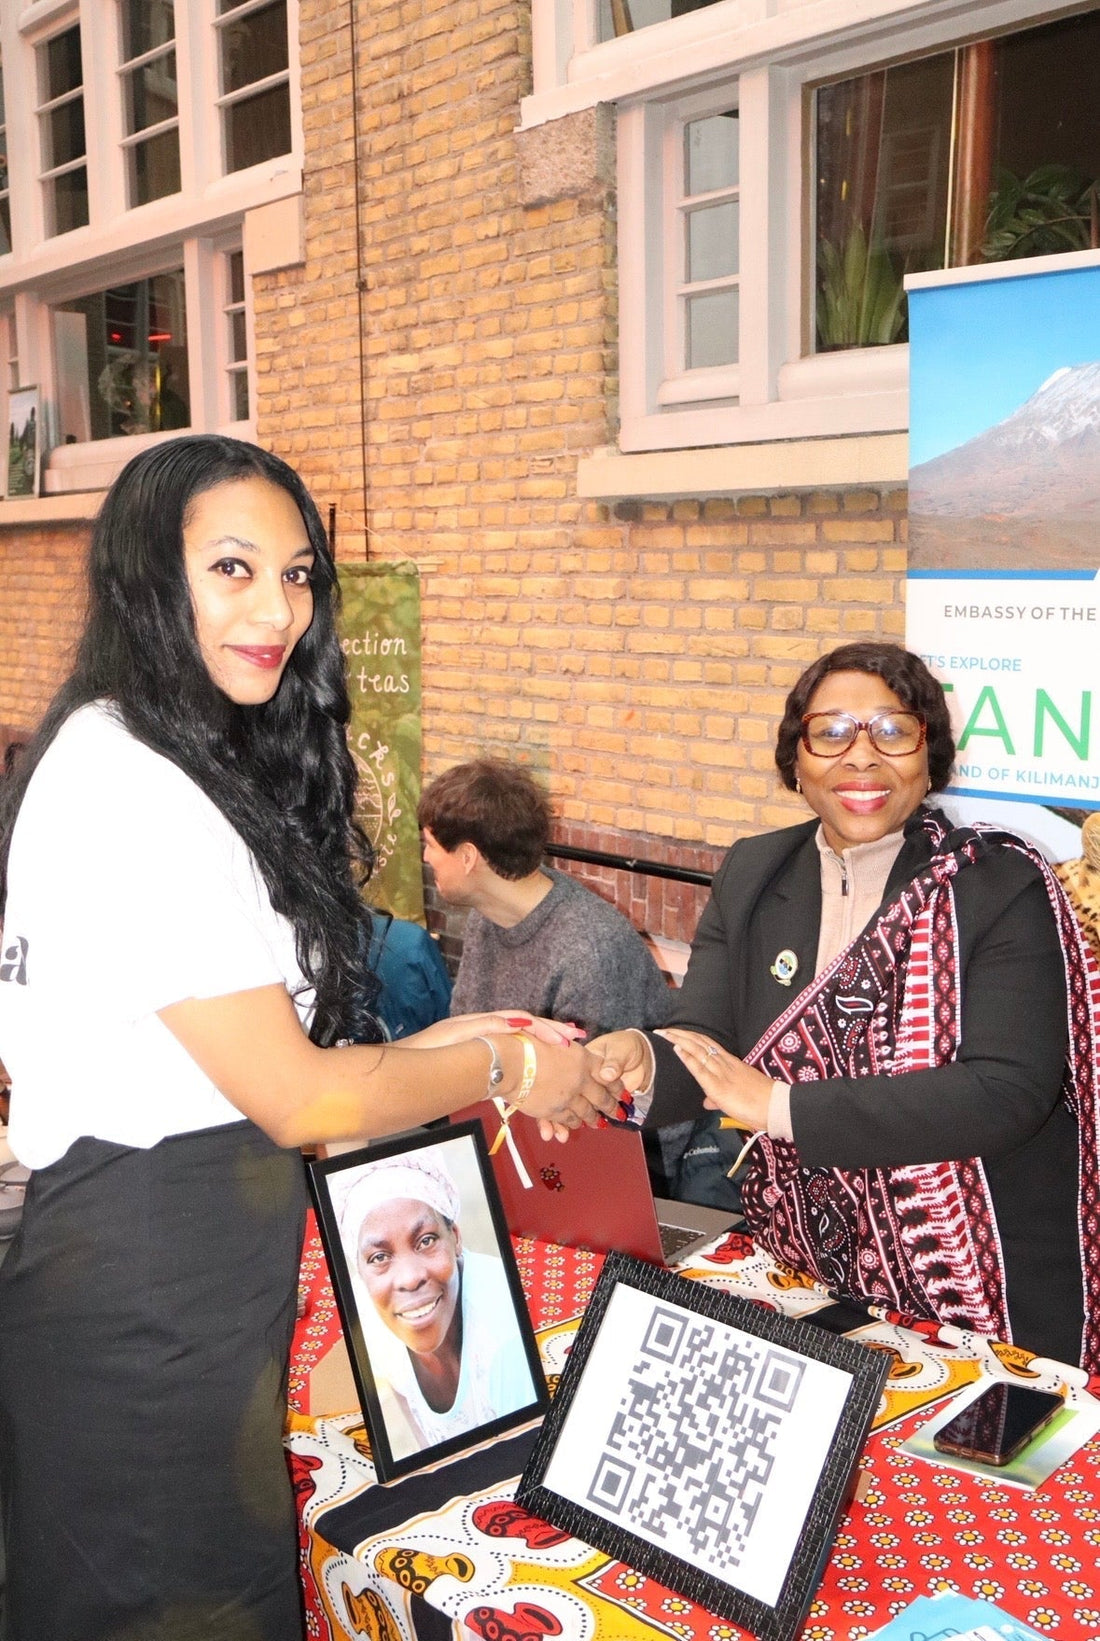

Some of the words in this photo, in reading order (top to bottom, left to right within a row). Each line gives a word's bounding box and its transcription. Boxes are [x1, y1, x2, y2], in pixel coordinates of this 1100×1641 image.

[944, 605, 1027, 619] EMBASSY
[1030, 606, 1055, 620] OF
[1059, 607, 1097, 621] THE
[340, 630, 407, 656] ection
[950, 656, 1022, 672] EXPLORE
[357, 666, 410, 693] teas
[988, 767, 1010, 781] OF
[1016, 769, 1100, 789] KILIMANJ
